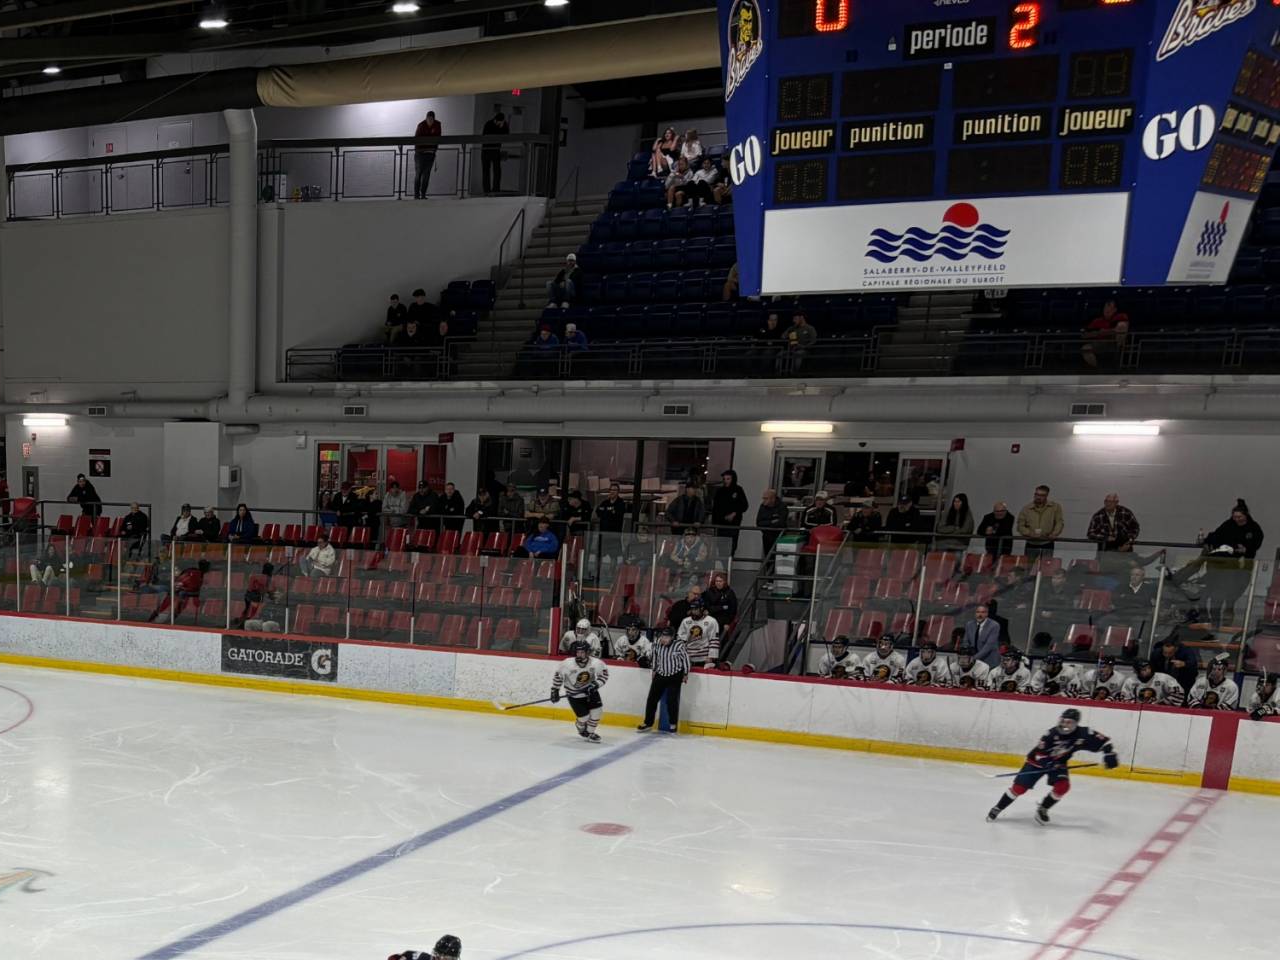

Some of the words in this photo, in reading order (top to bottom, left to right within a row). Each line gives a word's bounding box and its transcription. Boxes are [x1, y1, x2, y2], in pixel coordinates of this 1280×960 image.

[910, 21, 988, 54] periode
[1009, 2, 1039, 48] 2
[1156, 0, 1256, 62] Braves
[771, 129, 833, 155] joueur
[849, 122, 924, 148] punition
[962, 112, 1041, 140] punition
[1059, 107, 1132, 136] joueur
[1142, 104, 1216, 161] GO
[729, 135, 761, 186] GO
[862, 279, 900, 287] CAPITALE
[904, 277, 952, 286] RÉGIONALE
[863, 263, 1006, 275] SALABERRY-DE-VALLEYFIELD
[227, 647, 304, 666] GATORADE
[311, 649, 332, 675] G
